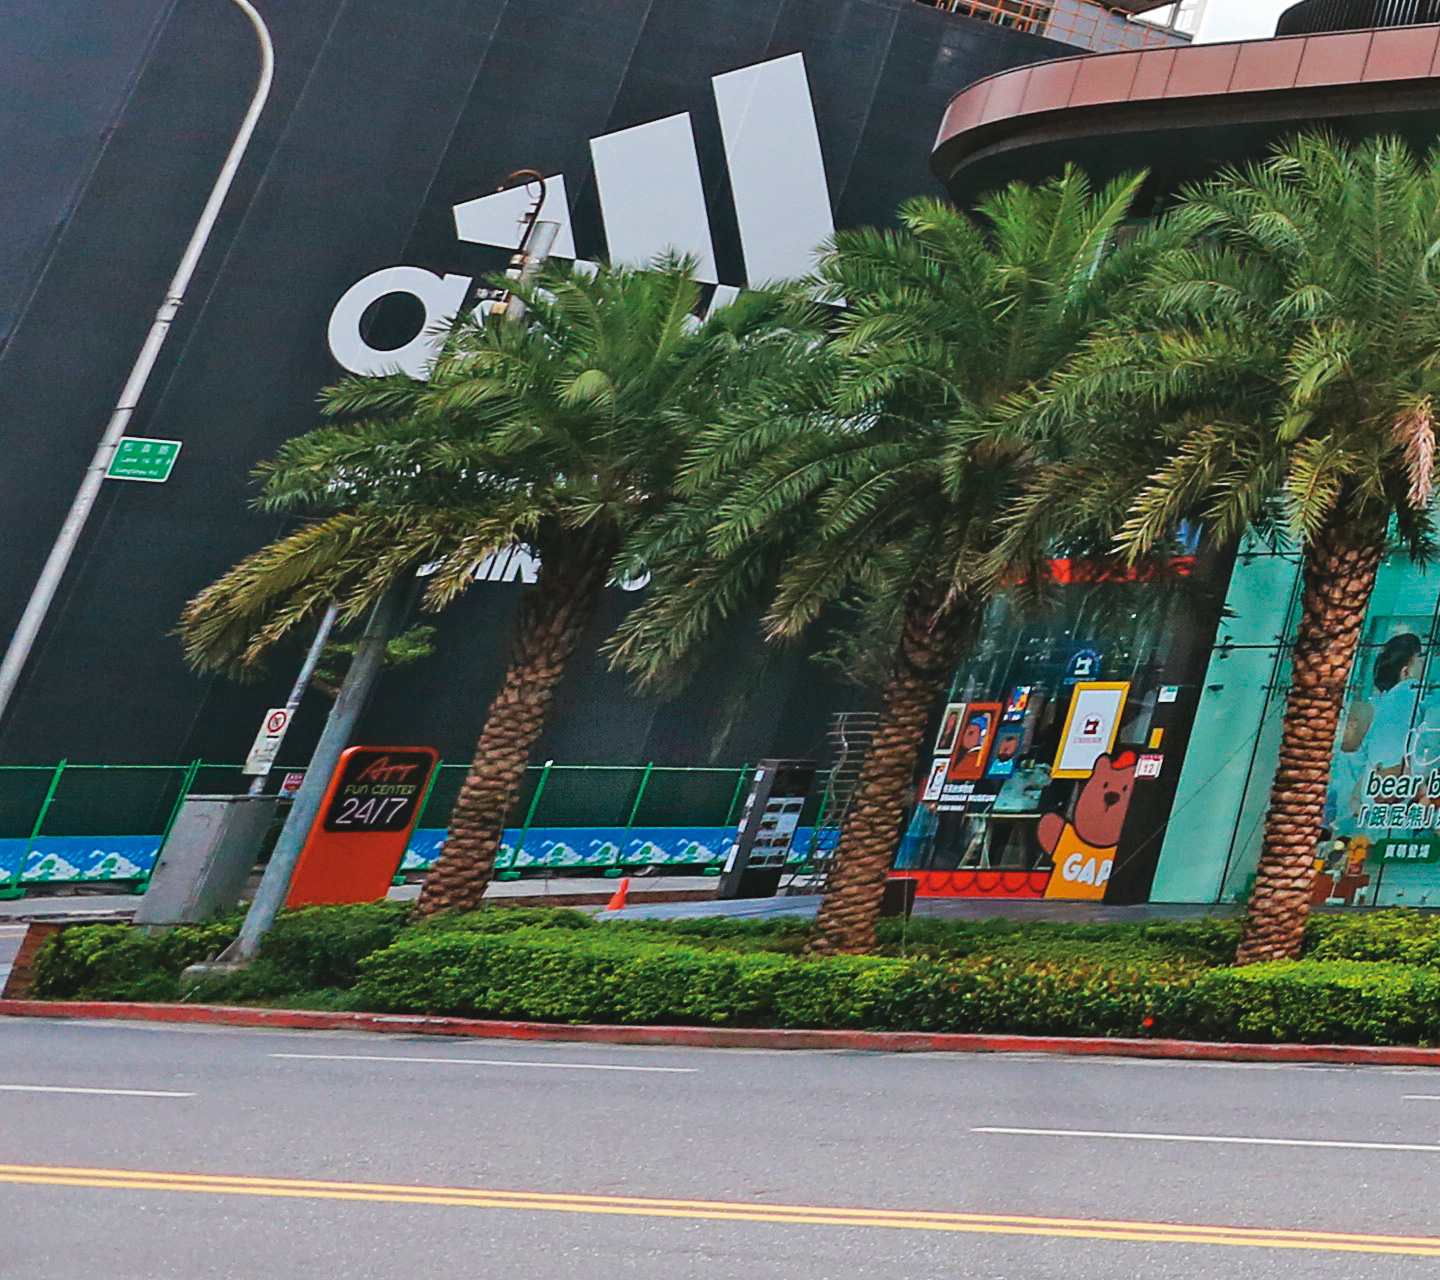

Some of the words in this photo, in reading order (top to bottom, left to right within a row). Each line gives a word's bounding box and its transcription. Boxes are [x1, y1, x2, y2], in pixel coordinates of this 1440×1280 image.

[1366, 769, 1422, 799] bear
[335, 797, 408, 824] 24/7
[1062, 852, 1114, 887] GAP
